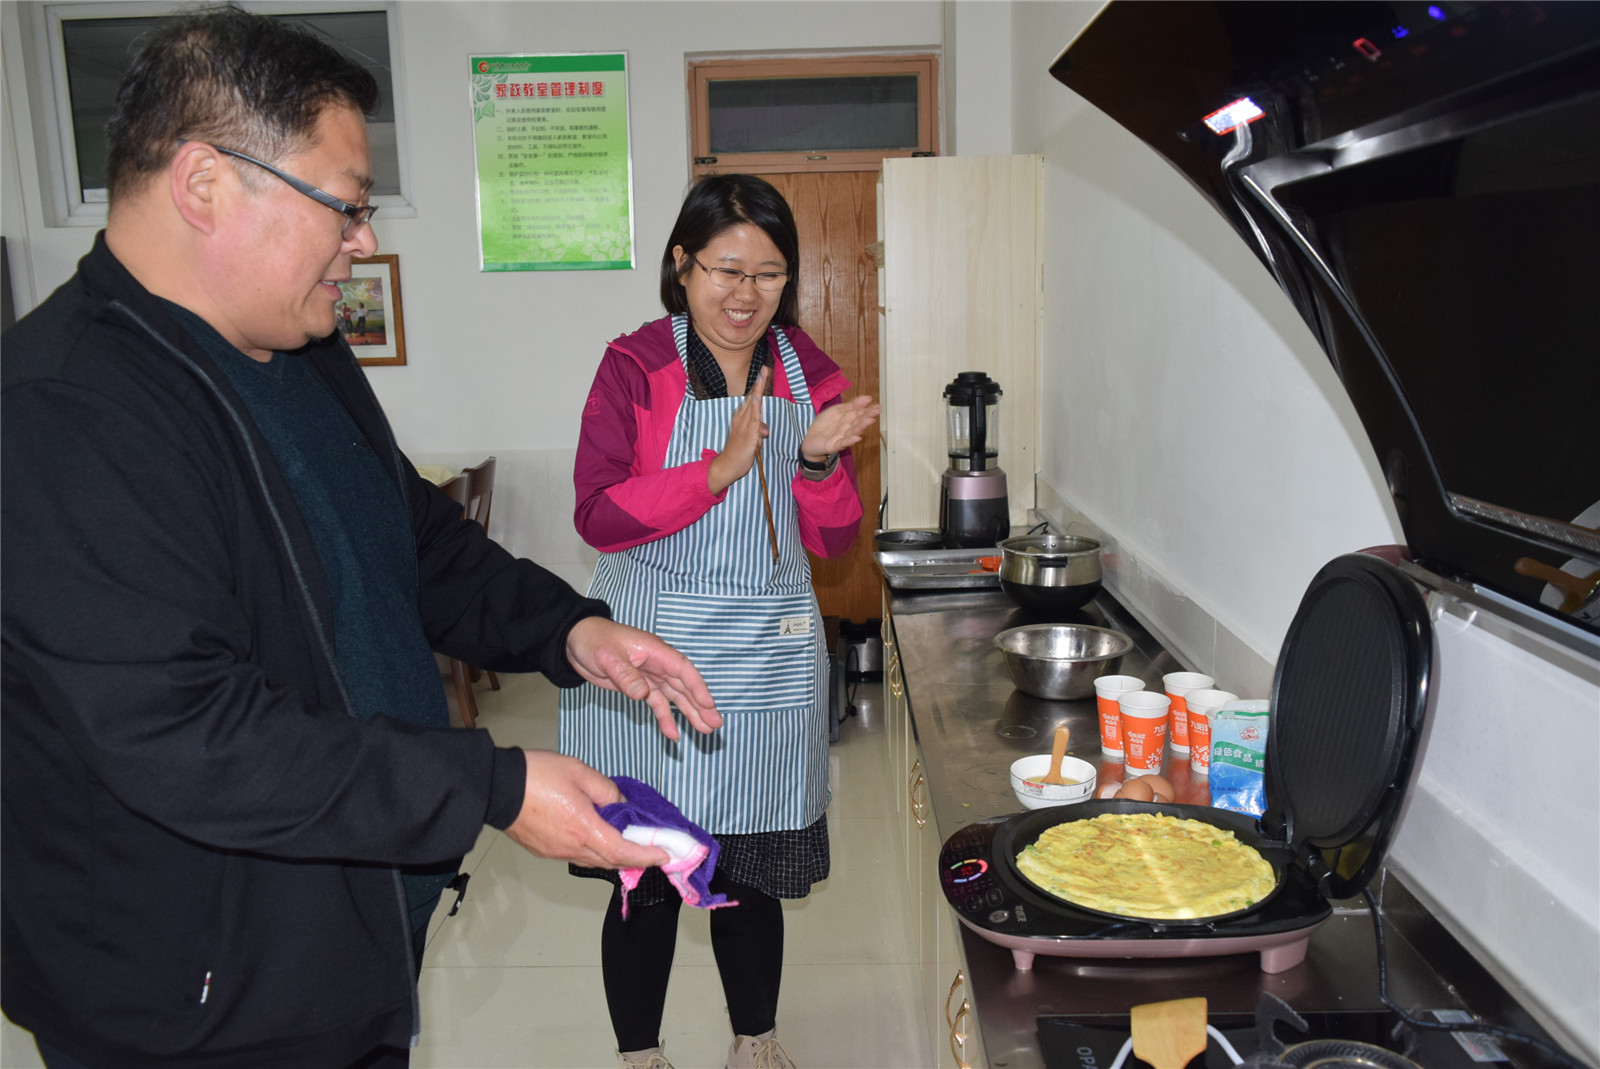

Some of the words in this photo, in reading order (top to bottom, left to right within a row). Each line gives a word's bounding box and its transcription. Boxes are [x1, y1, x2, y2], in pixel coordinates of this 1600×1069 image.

[496, 81, 603, 98] 家政教室管理制度
